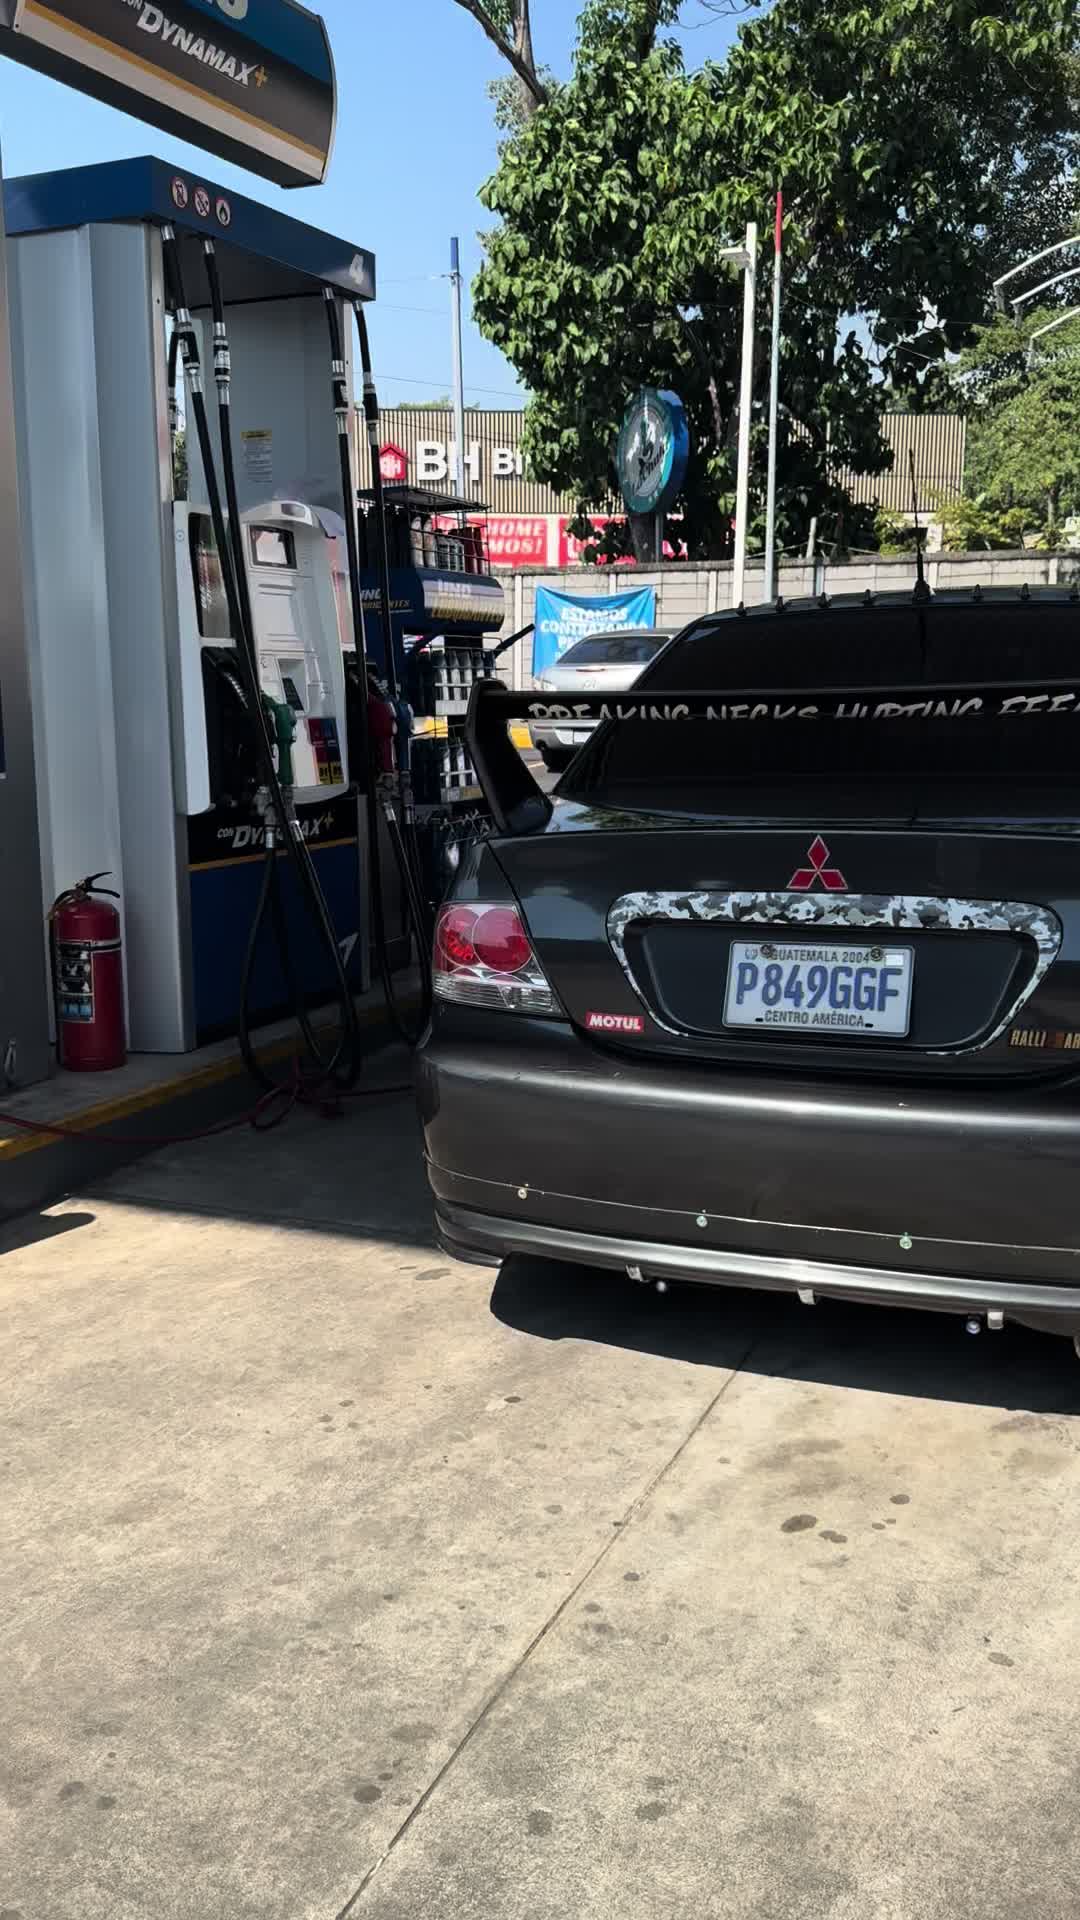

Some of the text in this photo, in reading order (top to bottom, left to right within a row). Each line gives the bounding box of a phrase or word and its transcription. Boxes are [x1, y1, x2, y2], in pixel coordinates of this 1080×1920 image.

[348, 253, 365, 285] 4
[416, 440, 481, 481] BH
[482, 537, 543, 555] MOS!
[771, 945, 871, 964] GUATEMALA 2004
[735, 961, 903, 1012] P849GGF
[588, 1013, 641, 1031] MOTUL
[764, 1010, 864, 1027] CENTRO AMÉRICA
